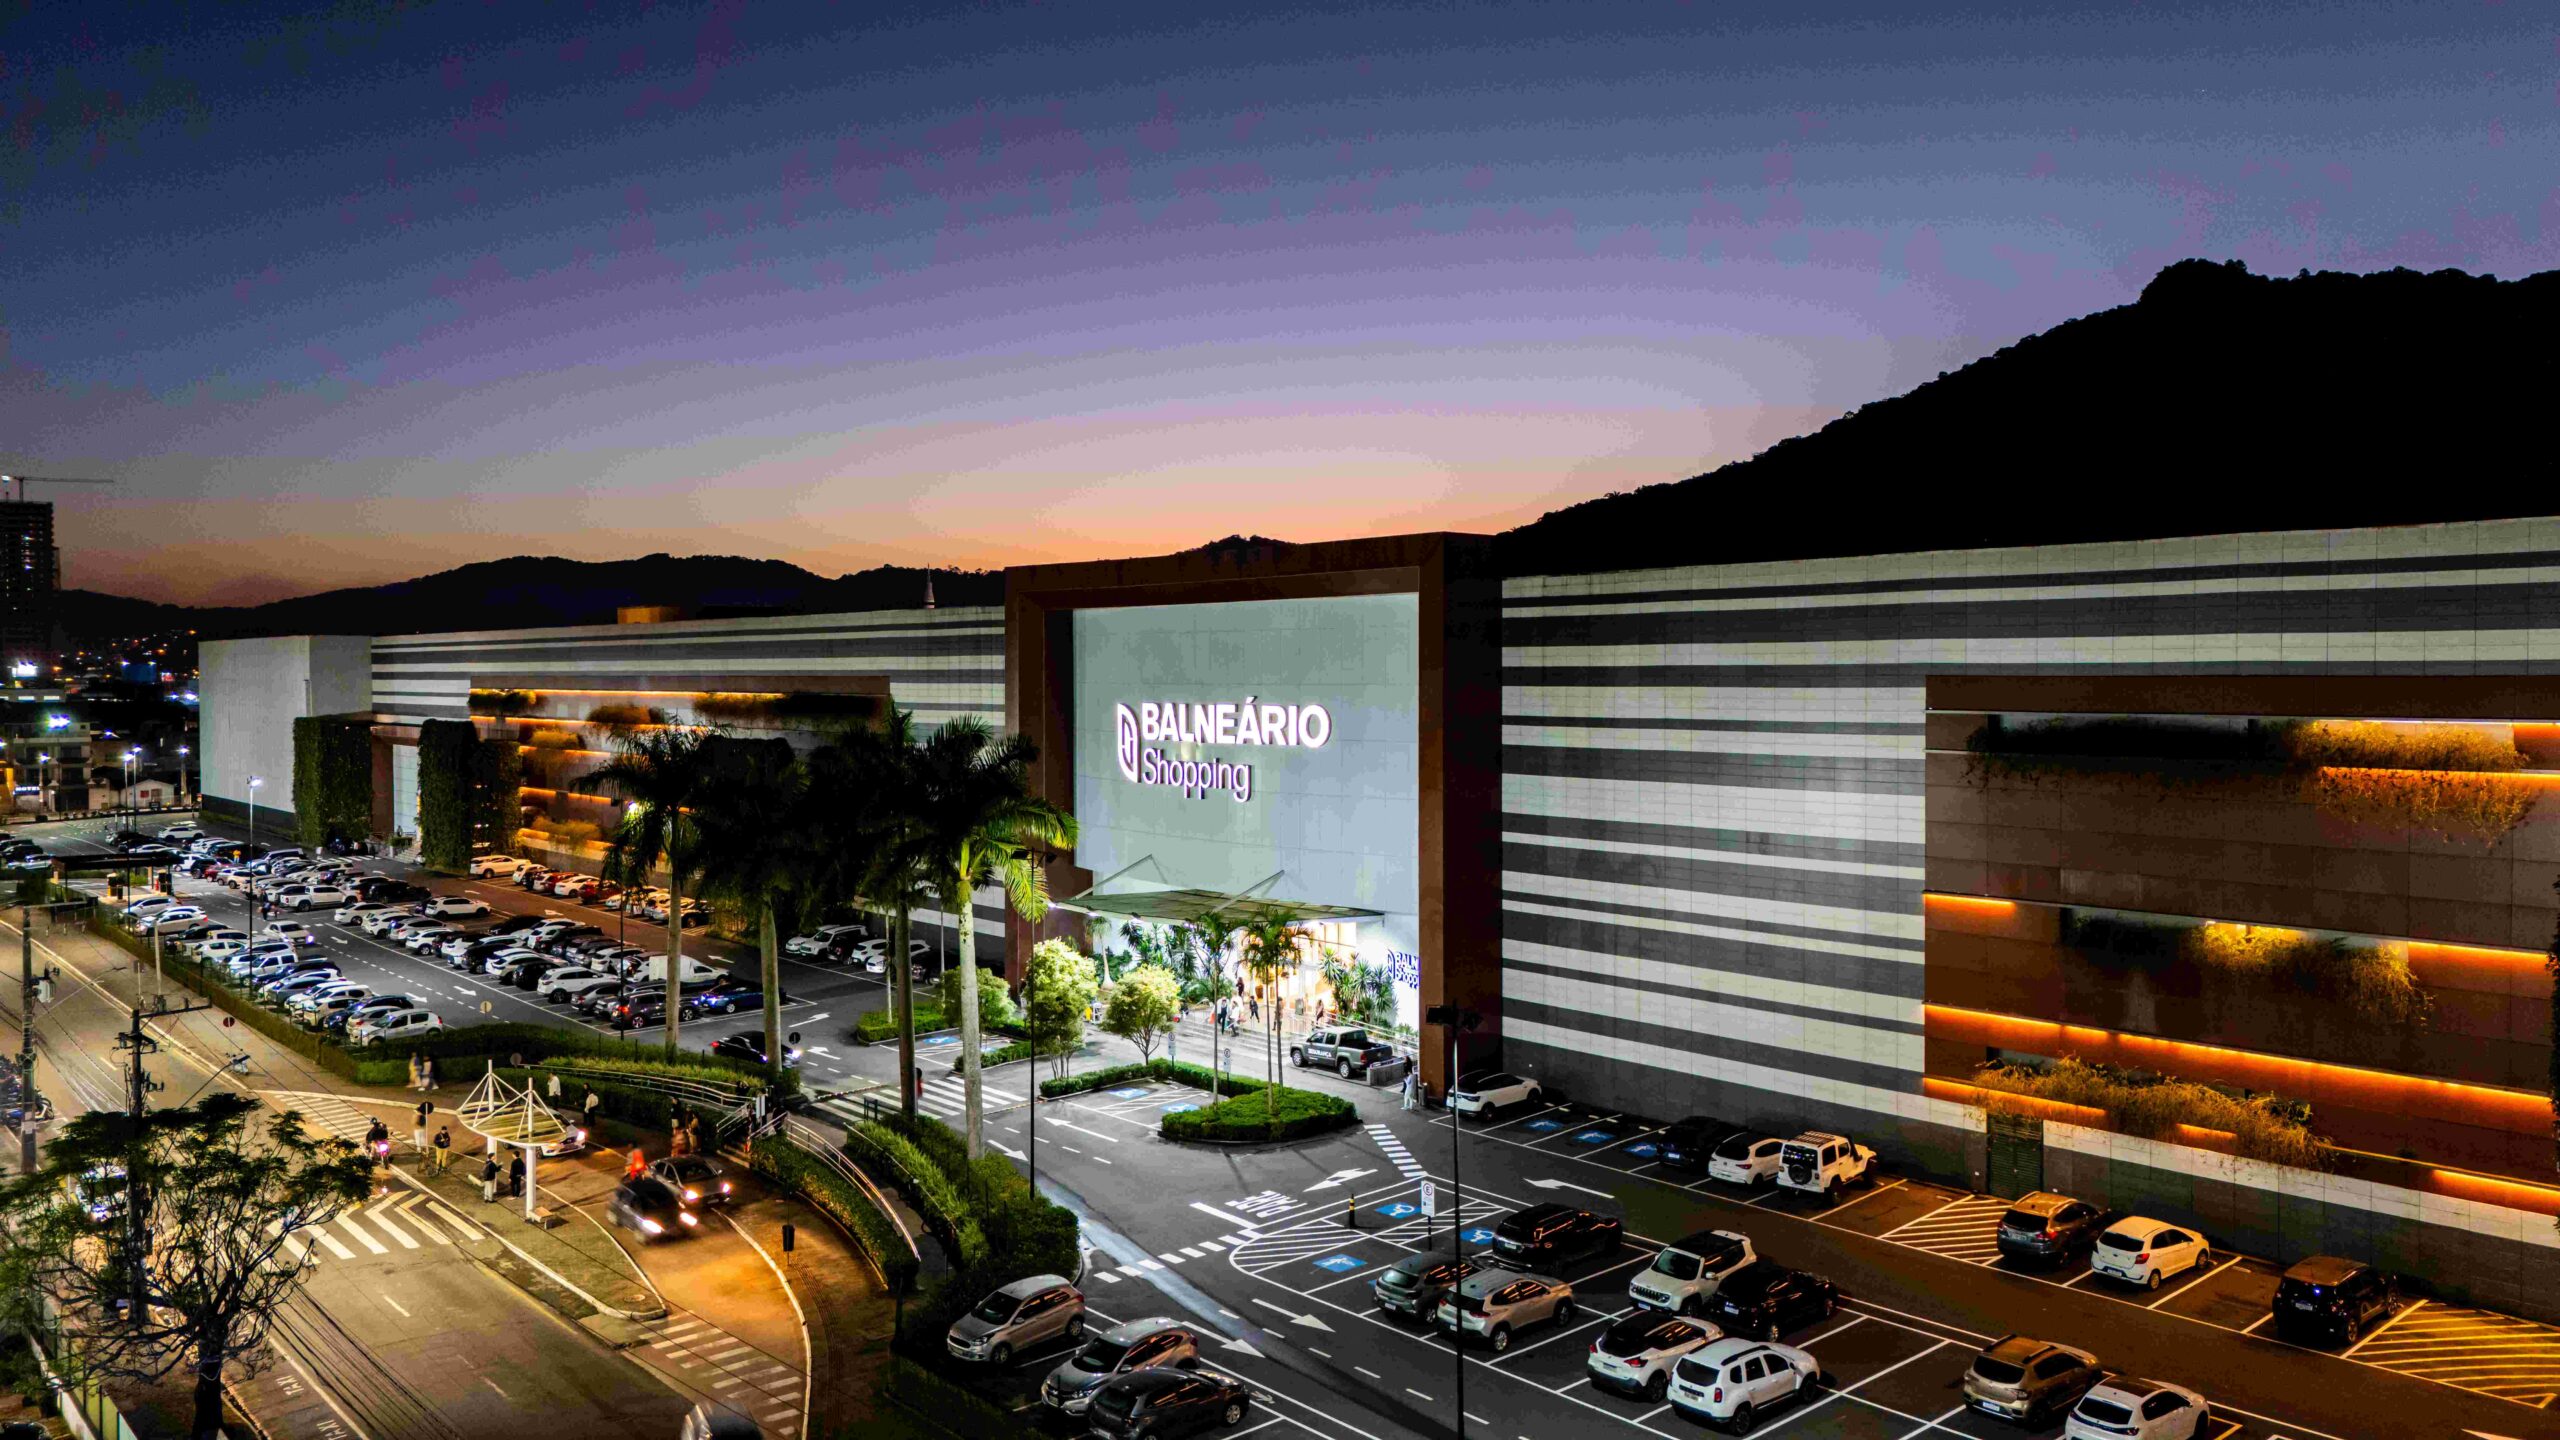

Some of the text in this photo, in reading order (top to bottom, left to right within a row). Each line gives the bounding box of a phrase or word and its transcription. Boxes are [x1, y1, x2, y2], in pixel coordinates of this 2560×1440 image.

[1141, 696, 1332, 748] BALNEÁRIO
[1142, 748, 1251, 802] Shopping
[1224, 1190, 1307, 1218] PARE
[275, 1375, 304, 1396] TAXI
[316, 1419, 348, 1440] TAXI
